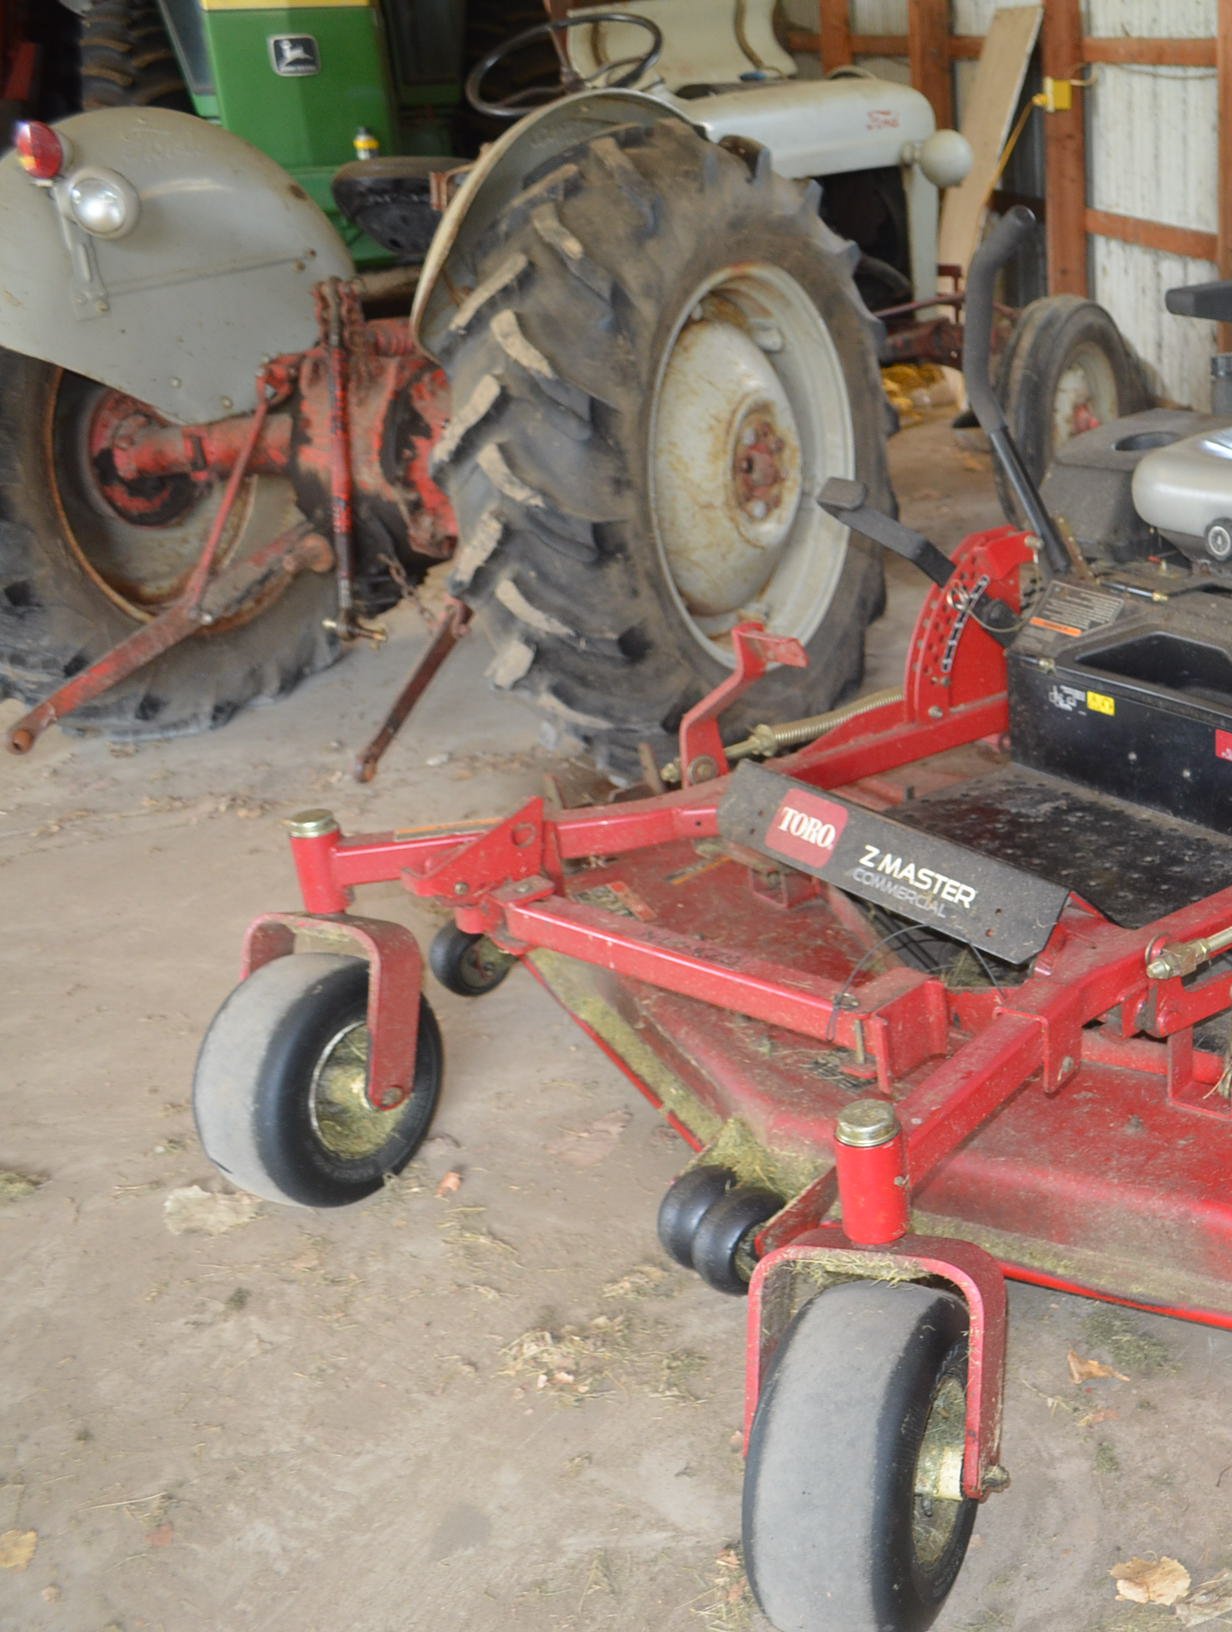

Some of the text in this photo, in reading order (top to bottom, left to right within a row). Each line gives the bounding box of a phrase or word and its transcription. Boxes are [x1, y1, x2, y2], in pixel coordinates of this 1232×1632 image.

[777, 806, 836, 848] TORO
[852, 867, 947, 919] COMMERCIAL
[858, 844, 977, 909] Z MASTER
